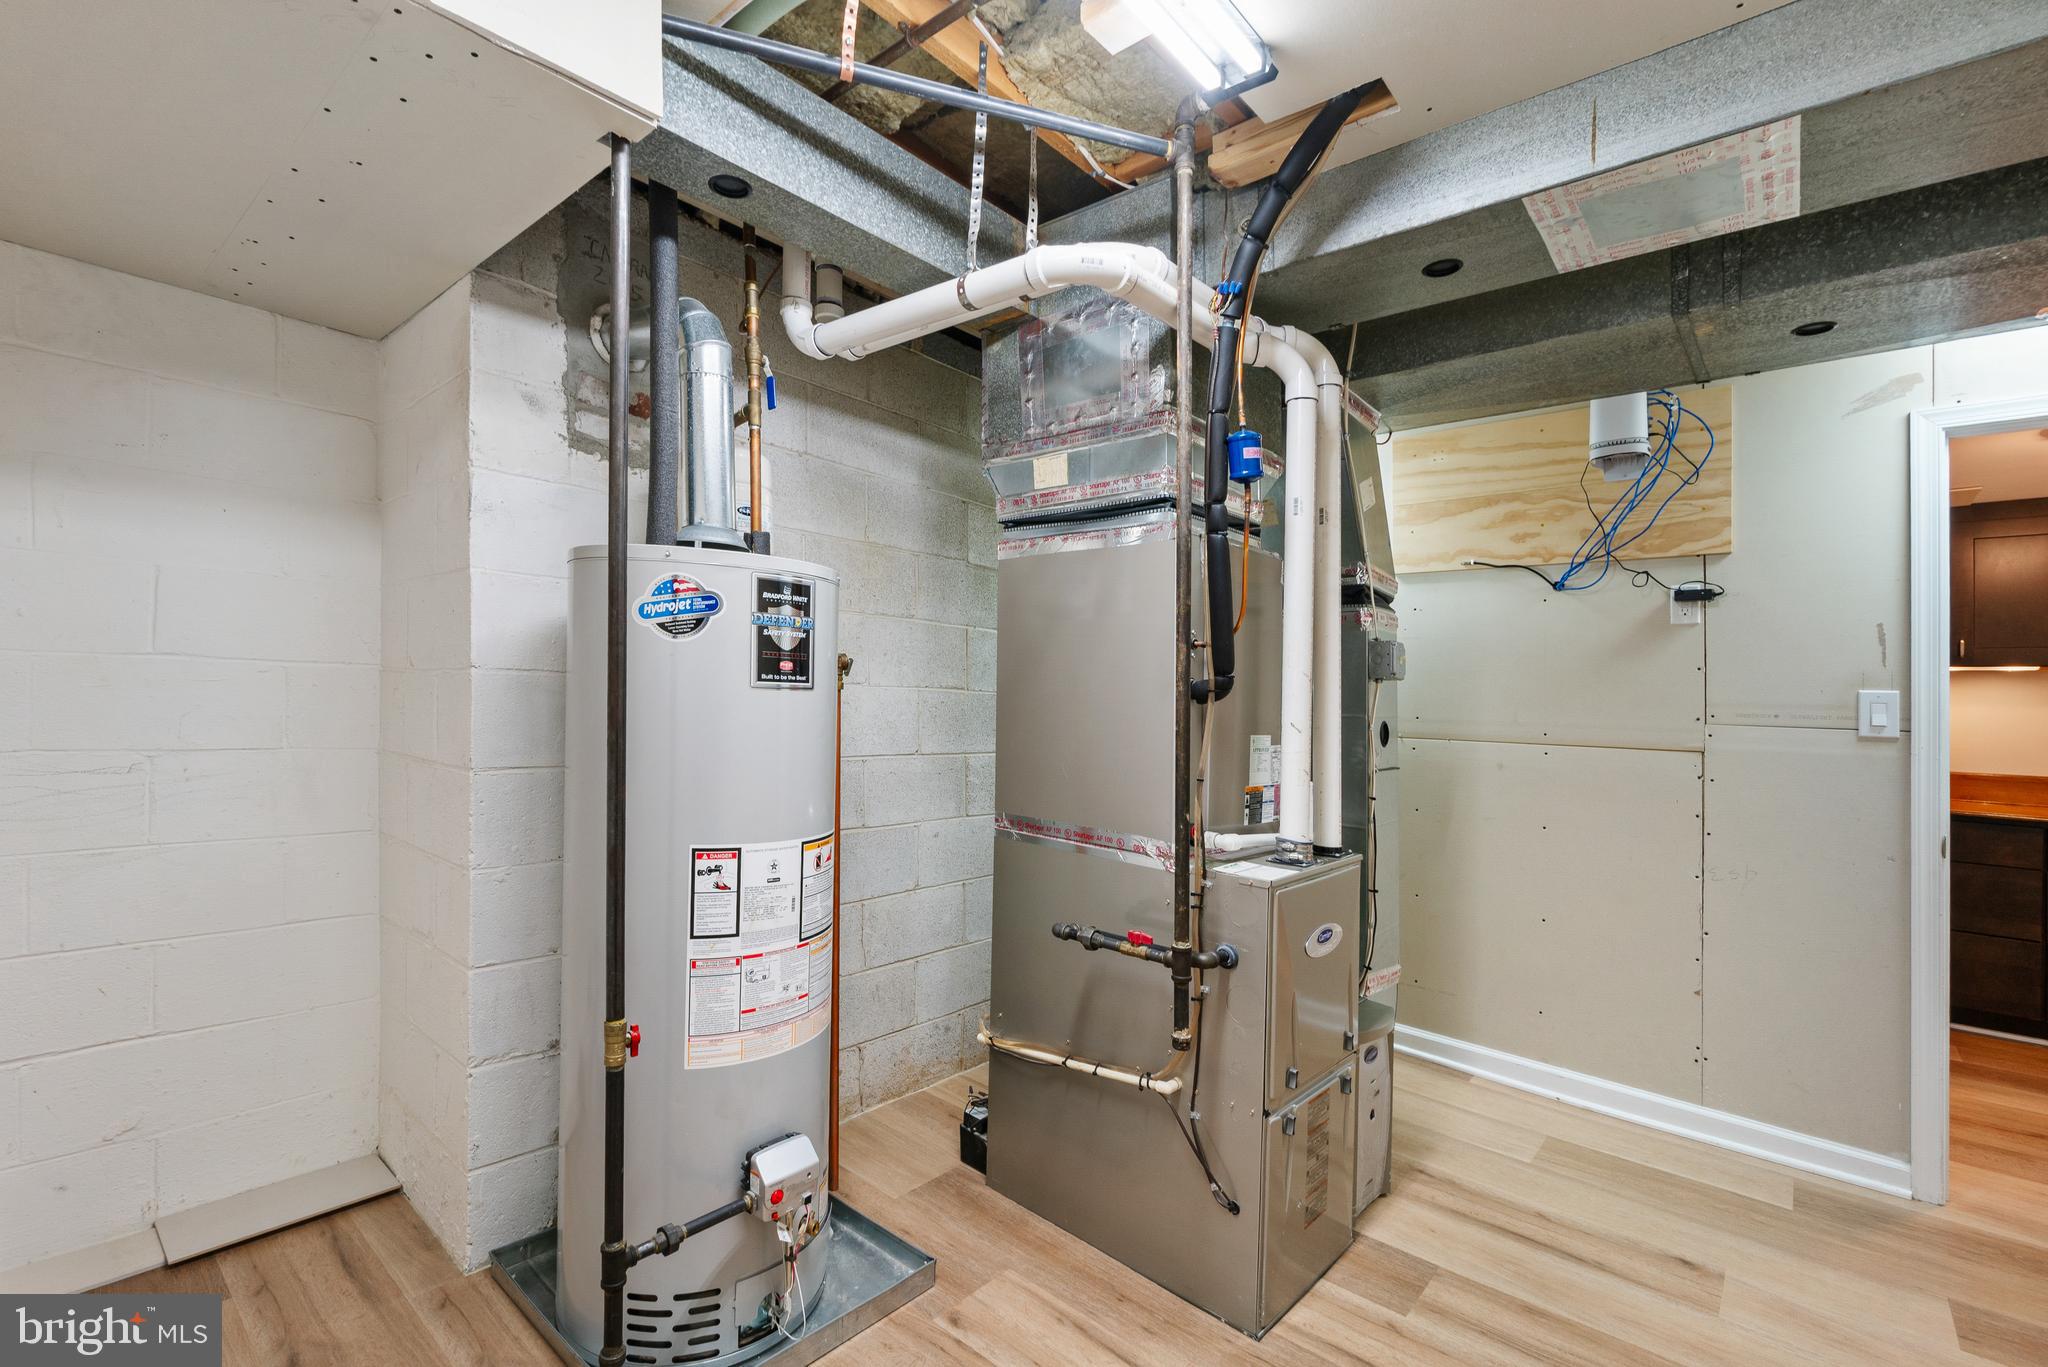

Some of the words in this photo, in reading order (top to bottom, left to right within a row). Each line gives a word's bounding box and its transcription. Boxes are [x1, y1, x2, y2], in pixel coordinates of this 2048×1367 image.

[762, 591, 792, 601] BRADFORD
[643, 599, 691, 615] Hydrojet
[752, 613, 813, 629] DEFENDER
